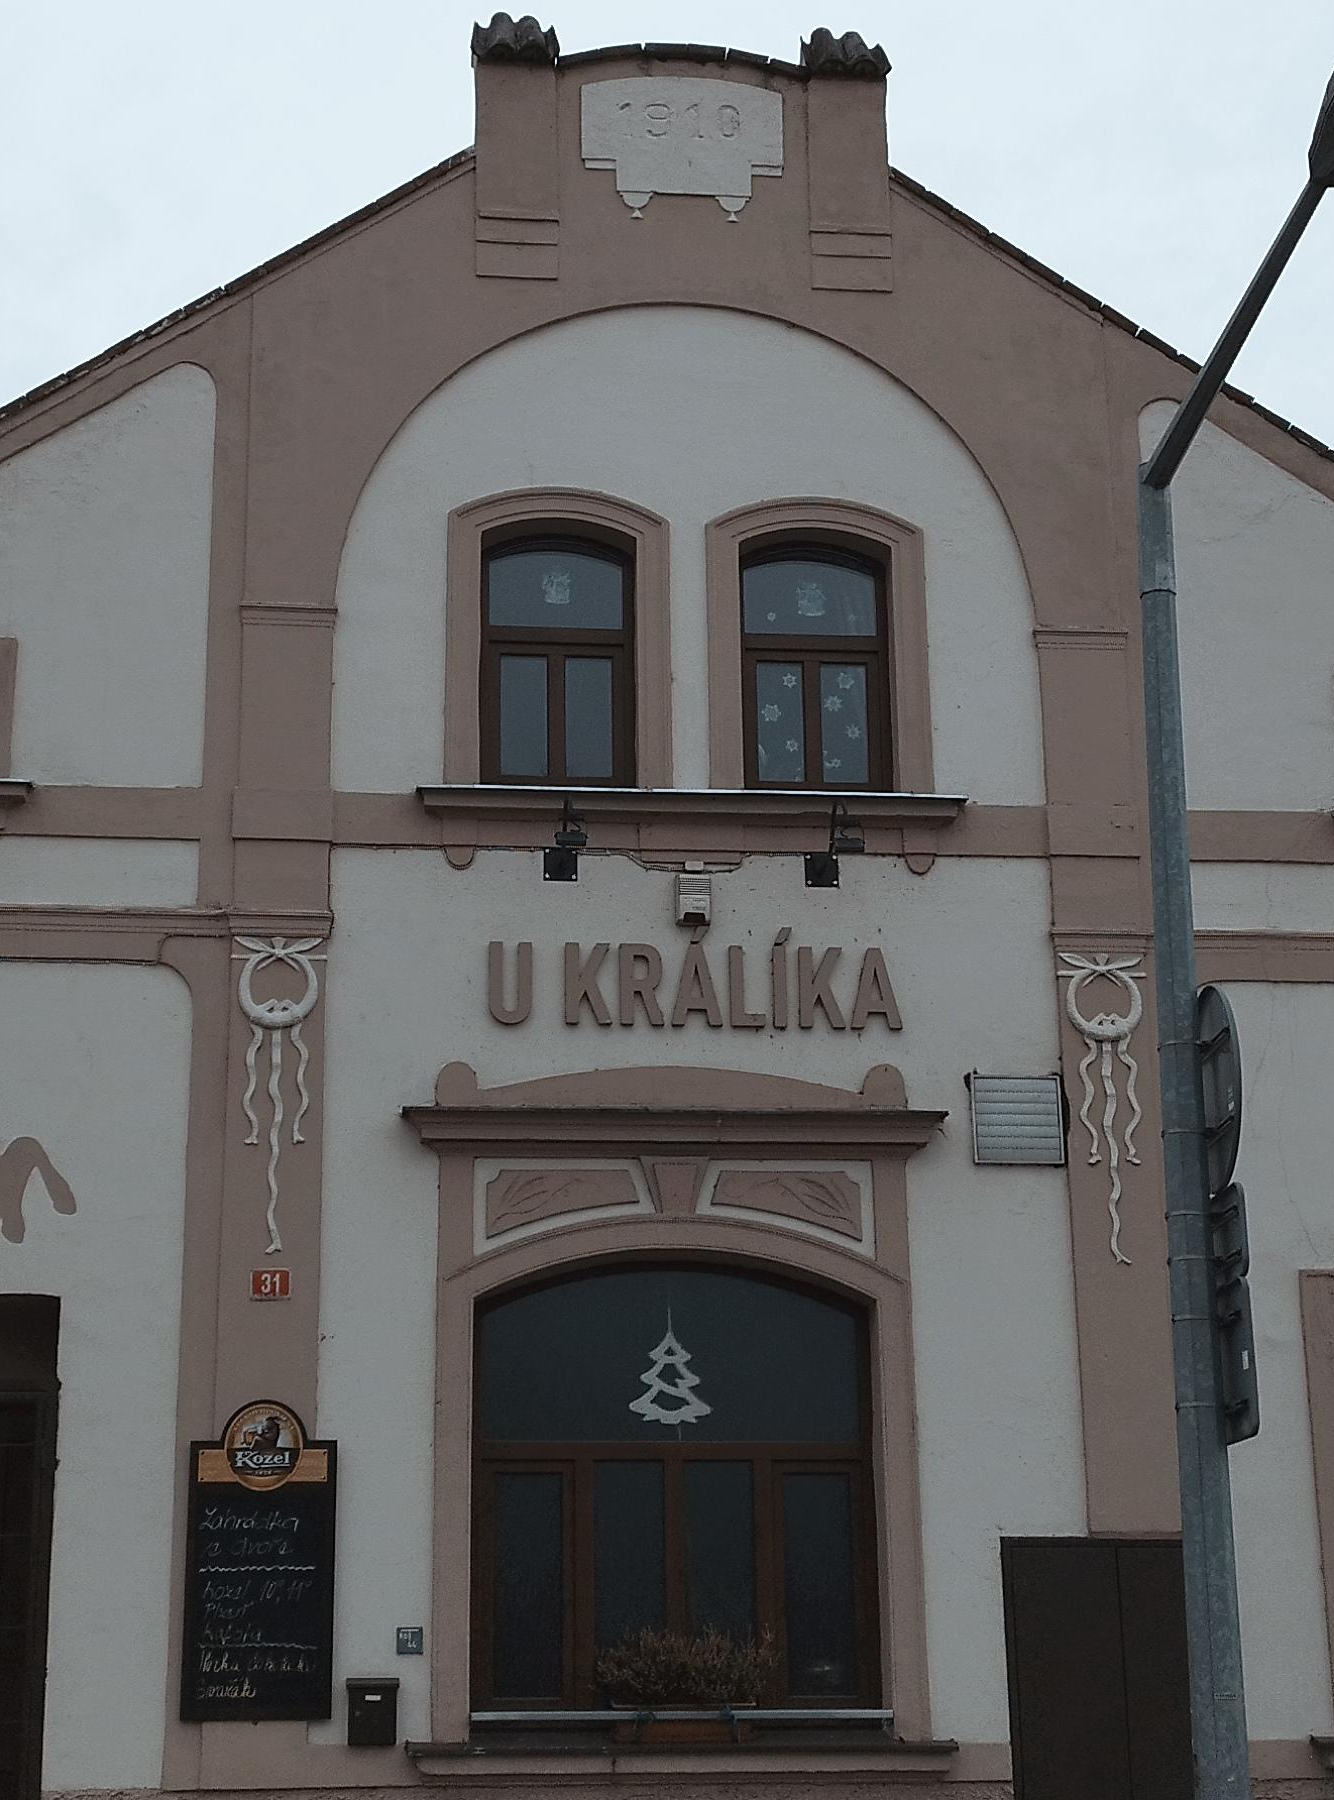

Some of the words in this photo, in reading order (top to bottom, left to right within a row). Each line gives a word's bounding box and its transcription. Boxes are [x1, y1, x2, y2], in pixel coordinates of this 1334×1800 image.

[487, 940, 533, 1025] U
[564, 926, 902, 1030] KRÁLÍKA
[261, 1273, 280, 1294] 31
[234, 1450, 290, 1469] Kozel
